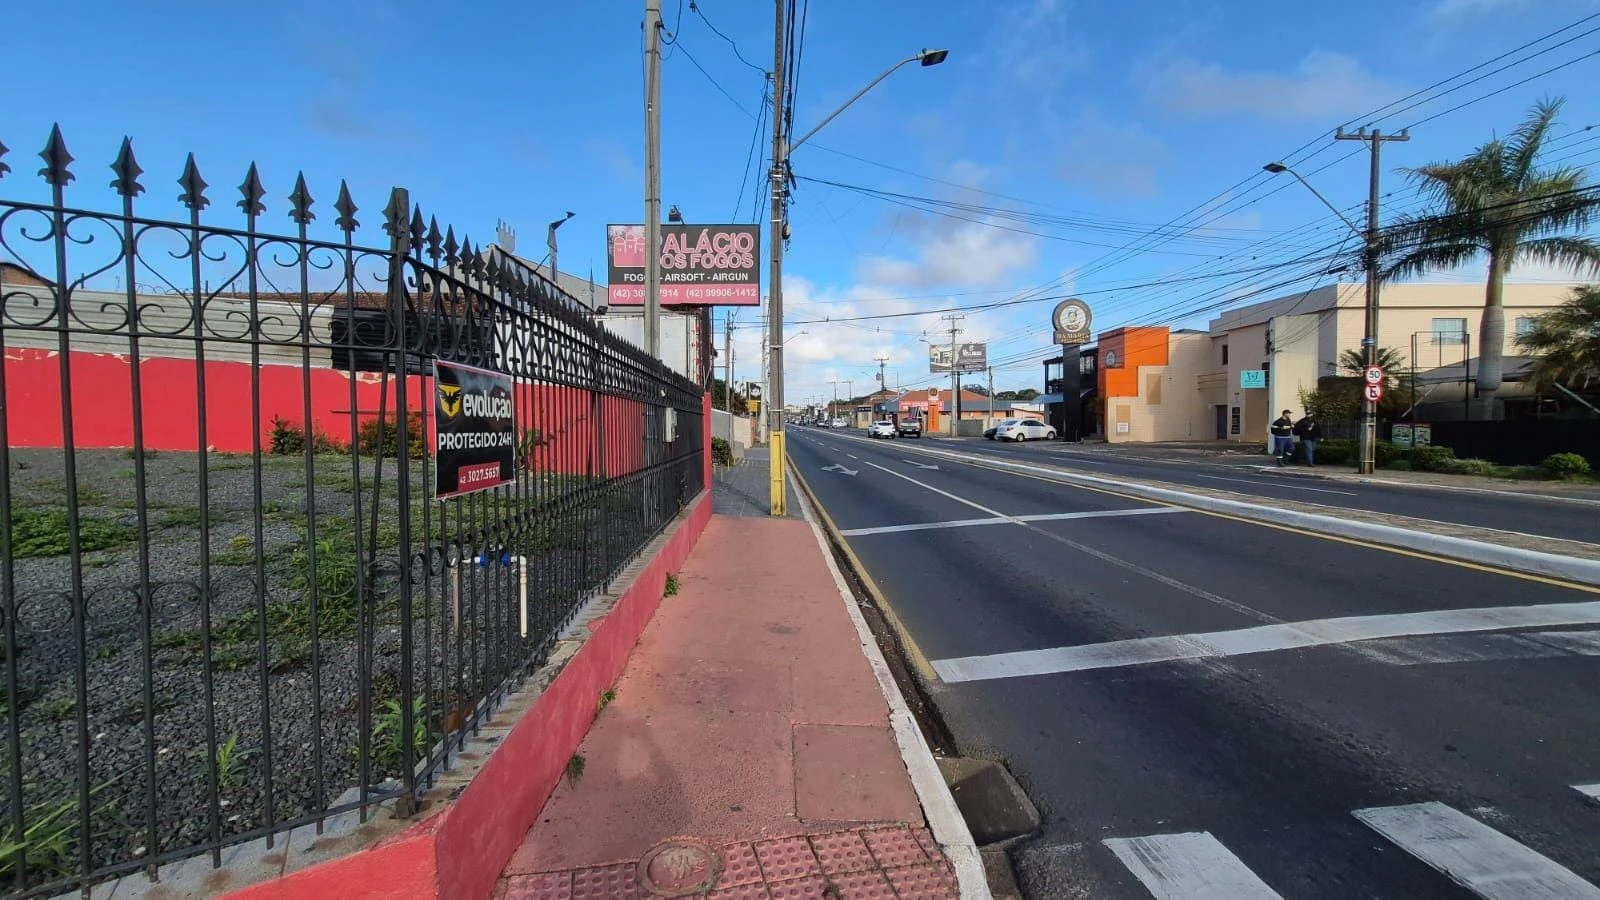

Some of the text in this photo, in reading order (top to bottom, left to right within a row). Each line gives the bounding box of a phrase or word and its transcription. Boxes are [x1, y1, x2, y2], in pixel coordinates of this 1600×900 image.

[660, 229, 754, 254] ALÁCIO
[660, 253, 754, 269] OS FOGOS
[624, 273, 646, 282] FOG
[664, 273, 705, 282] AIRSOFT
[712, 272, 749, 281] AIRGUN
[613, 288, 630, 300] (42)
[686, 288, 703, 299] (42)
[705, 288, 757, 297] 99906-1412
[1369, 370, 1380, 379] 50
[463, 390, 512, 421] evolução
[438, 431, 513, 451] PROTEGIDO 24H
